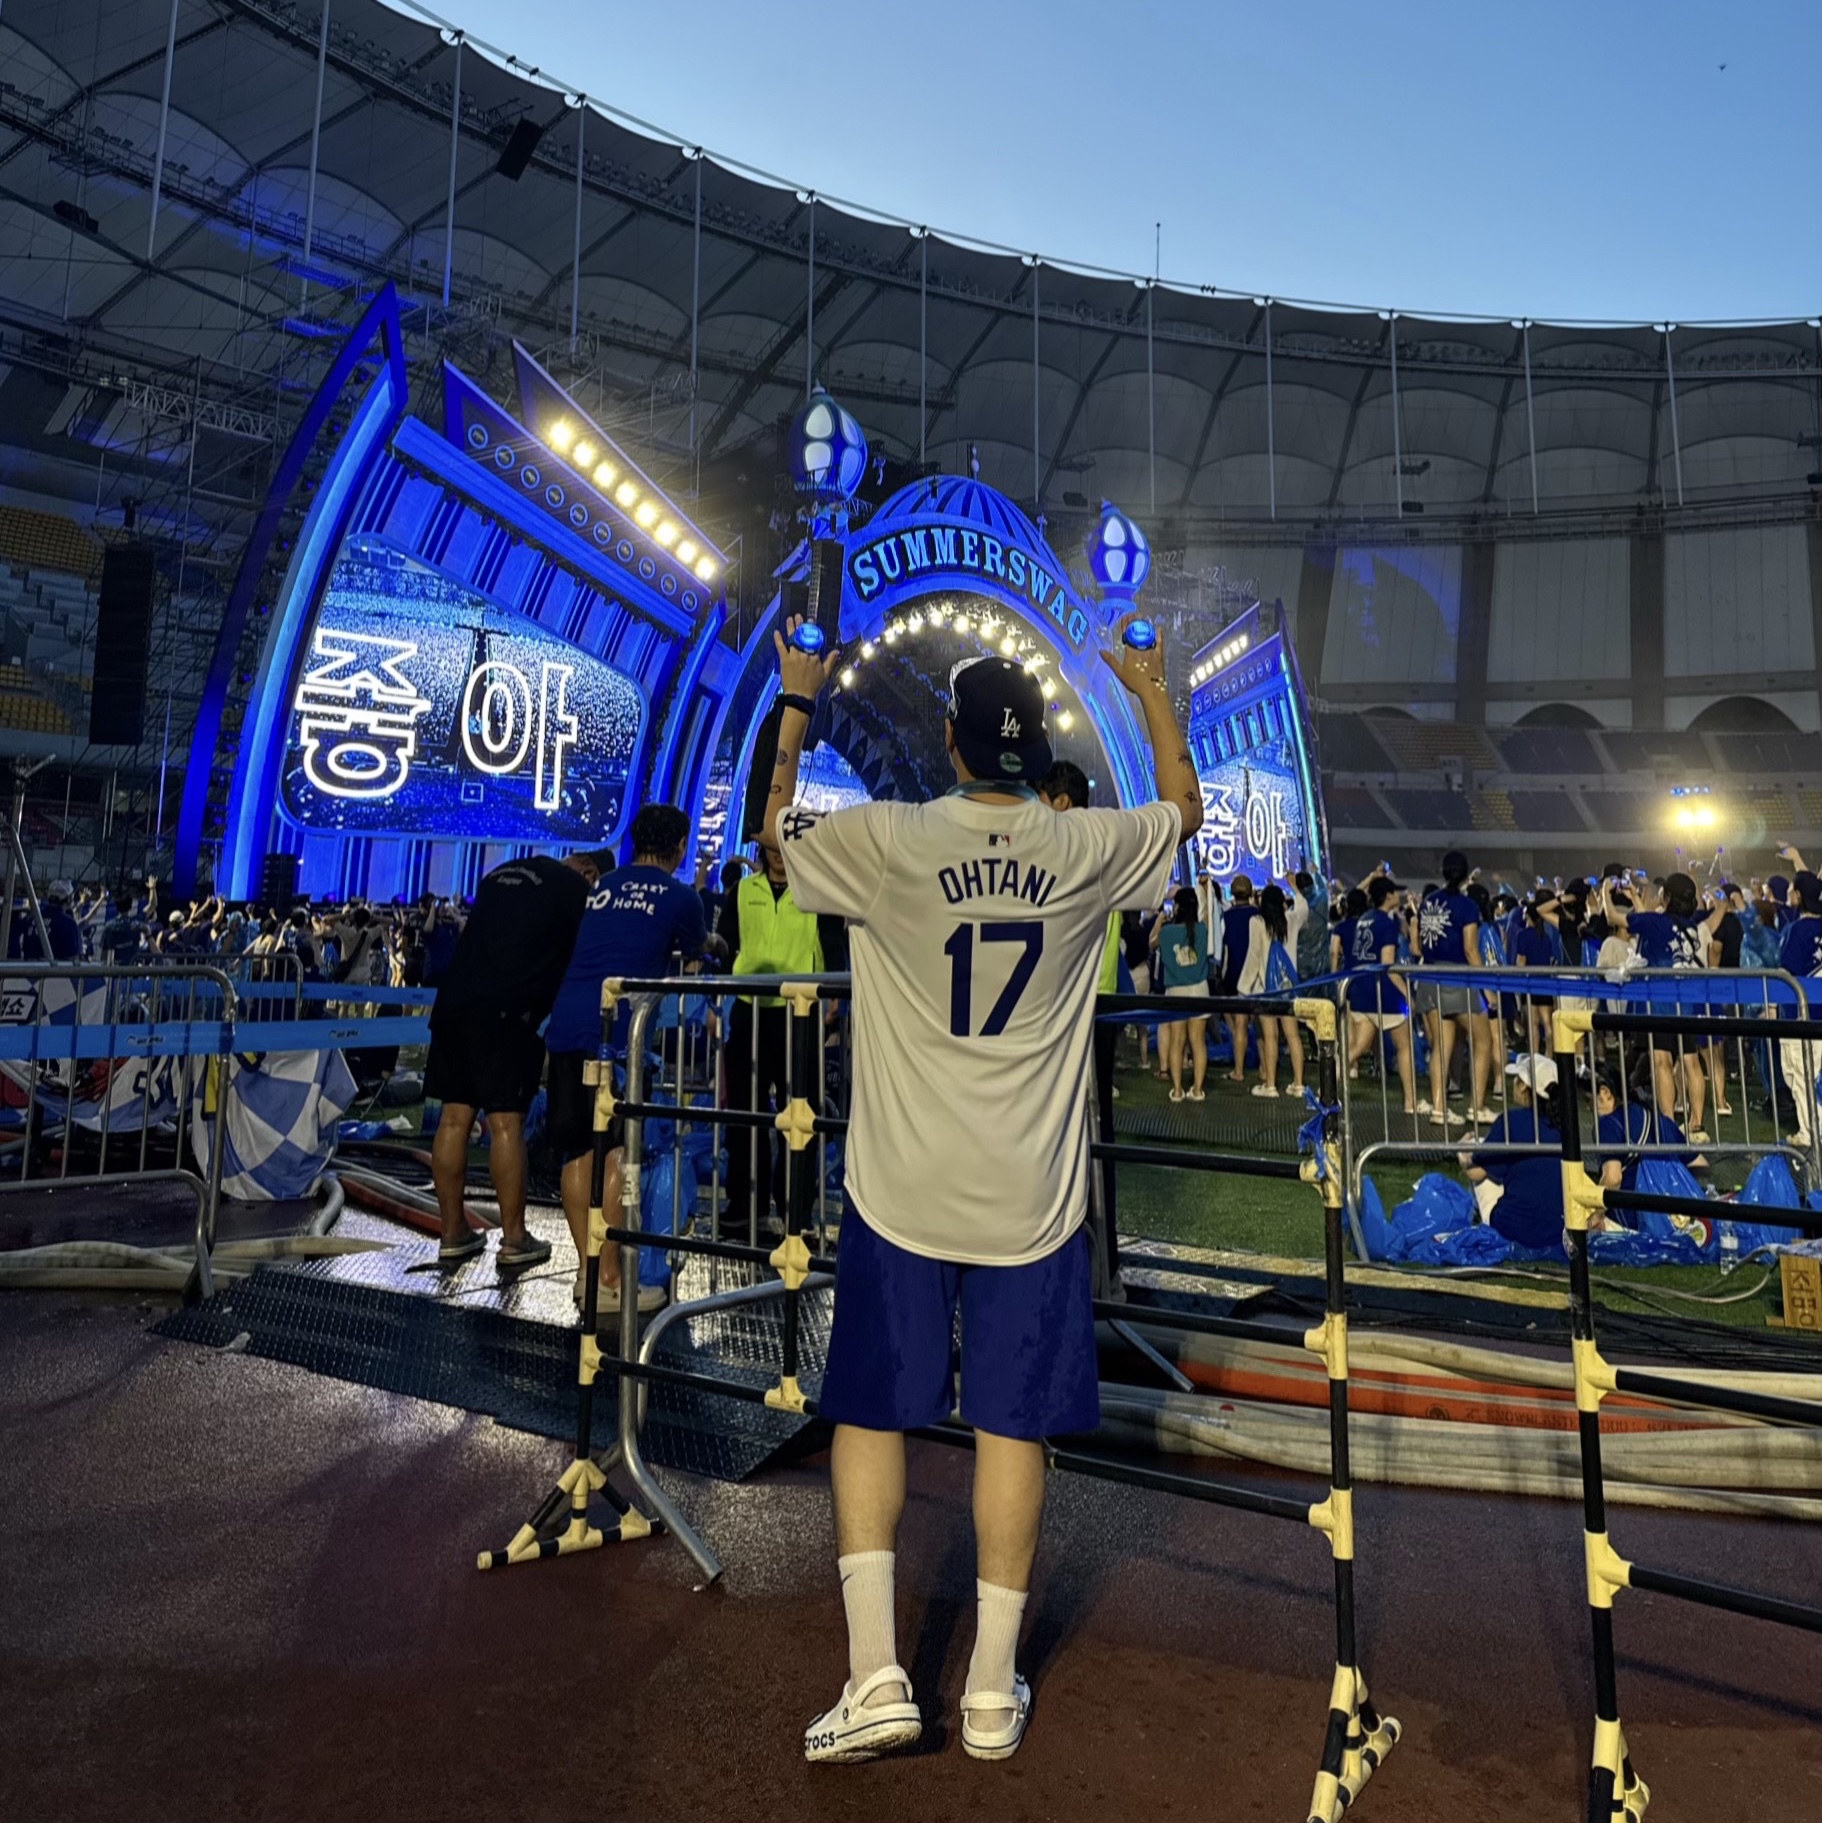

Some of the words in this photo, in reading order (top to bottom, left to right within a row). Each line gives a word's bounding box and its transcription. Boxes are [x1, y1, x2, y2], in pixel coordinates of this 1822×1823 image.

[295, 626, 579, 811] 좋아
[1001, 707, 1021, 738] LA
[621, 880, 668, 896] CRAZY
[630, 891, 645, 901] OR
[938, 858, 1057, 908] OHTANI
[612, 897, 655, 916] HOME
[944, 921, 1044, 1038] 17
